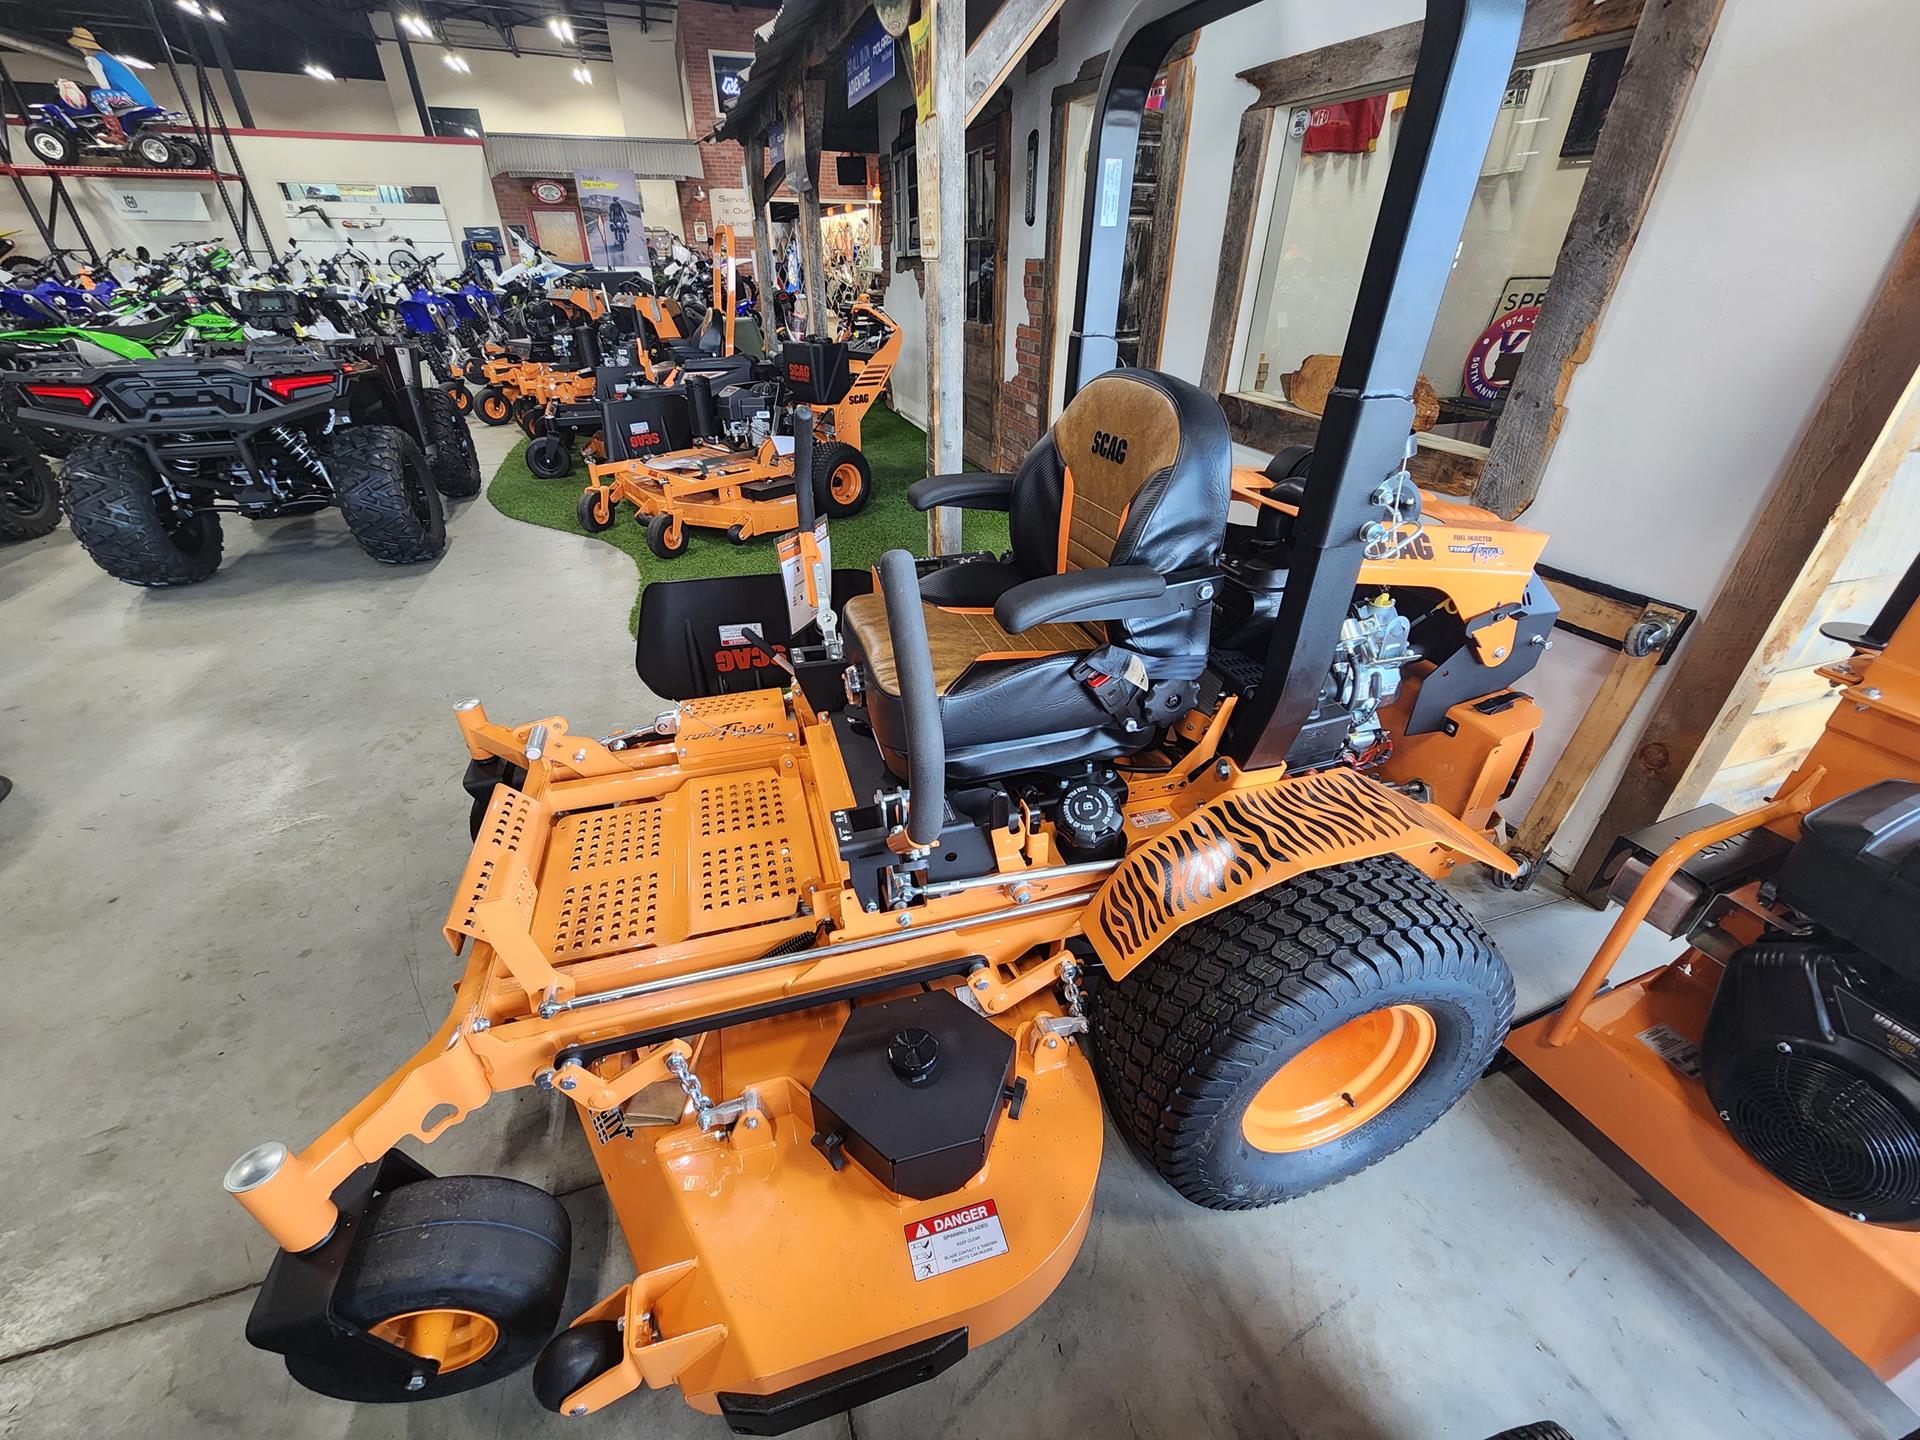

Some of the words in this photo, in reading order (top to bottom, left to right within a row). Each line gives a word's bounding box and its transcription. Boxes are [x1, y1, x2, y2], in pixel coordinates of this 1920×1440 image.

[733, 207, 750, 215] Our
[1501, 314, 1523, 330] 1974
[788, 363, 810, 378] SCAG
[1470, 356, 1480, 383] 50TH
[849, 394, 869, 405] SCAG
[629, 432, 661, 448] SCAG
[1091, 430, 1128, 465] SCAG
[933, 1205, 989, 1232] DANGER
[943, 1229, 968, 1241] SPINNING
[967, 1222, 989, 1233] BLADES
[967, 1235, 981, 1243] CLEAR
[944, 1252, 957, 1260] BLADE
[957, 1246, 977, 1257] CONTACT
[980, 1240, 998, 1249] THROWN
[951, 1255, 970, 1264] OBJECTS
